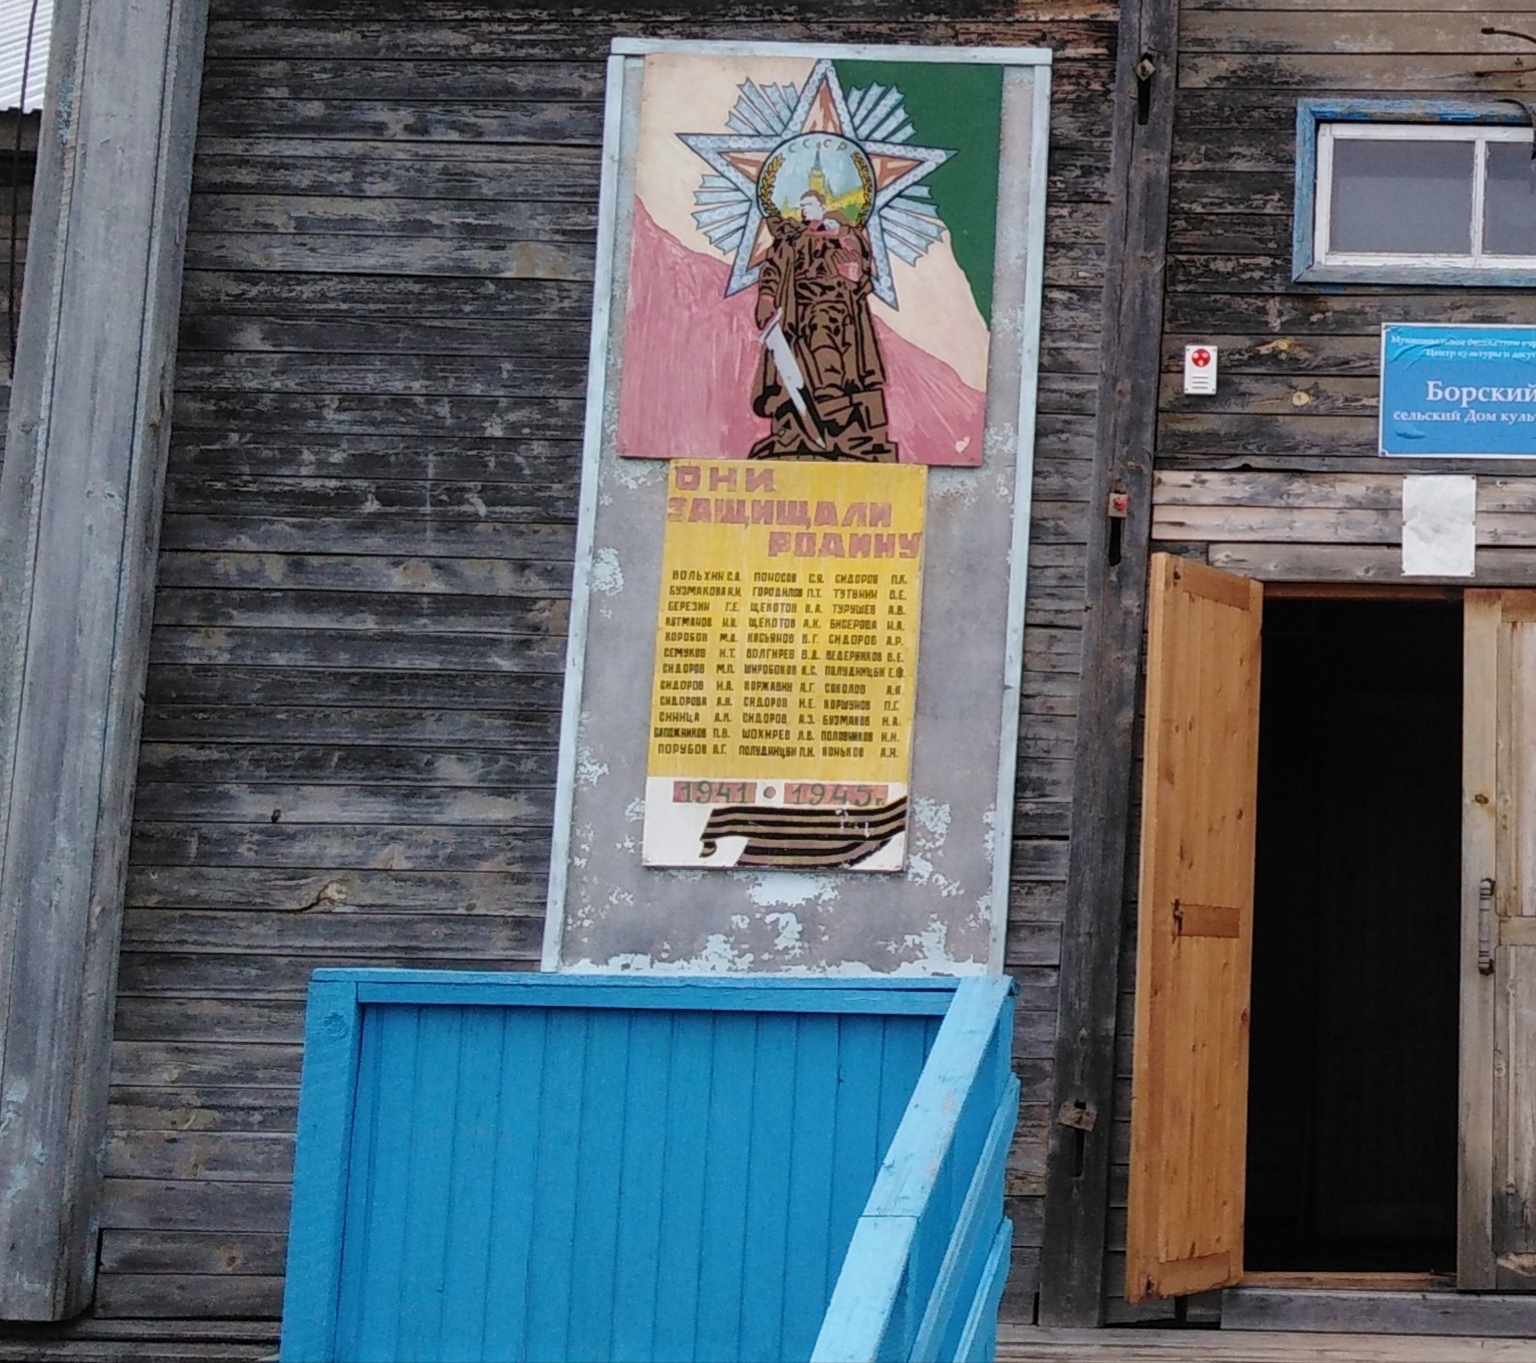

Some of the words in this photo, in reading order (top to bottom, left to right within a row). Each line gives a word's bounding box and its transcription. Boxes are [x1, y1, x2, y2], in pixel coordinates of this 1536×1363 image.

[1393, 409, 1460, 421] сельский
[1464, 409, 1496, 423] Дом
[675, 465, 774, 493] ОНИ
[668, 497, 892, 529] ЗАЩИЩАЛИ
[768, 531, 922, 559] РОДИНУ
[672, 570, 724, 580] ВОЛЬХИН
[754, 572, 796, 582] ПОНОСОВ
[835, 574, 878, 584] СИДОРОВ
[670, 585, 726, 596] БУЗМАКОВА
[753, 587, 803, 597] ГОРОДИЛОВ
[807, 588, 821, 598] П.Т.
[668, 602, 710, 611] БЕРЕЗИН
[725, 602, 739, 611] Г.Е.
[750, 602, 797, 613] ЩЕКОТОВ
[833, 604, 876, 614] ТУРУШЕВ
[749, 617, 796, 628] ЩЕКОТОВ
[830, 619, 877, 630] БИСЕРОВА
[748, 633, 794, 643] КАСЬЯНОВ
[802, 634, 819, 644] В.Г.
[829, 634, 877, 645] СИДОРОВ
[664, 648, 706, 658] СЕМУКОВ
[663, 663, 705, 674] СИДОРОВ
[716, 664, 735, 674] М.П.
[744, 664, 797, 675] ШИРОБОКОВ
[660, 681, 703, 690] СИДОРОВ
[825, 683, 866, 694] СОКОЛОВ
[660, 696, 707, 706] СИДОРОВА
[744, 697, 788, 707] СИДОРОВ
[824, 700, 870, 710] КОРШУНОВ
[659, 712, 700, 723] СИНИЦА
[743, 713, 787, 724] СИДОРОВ
[823, 715, 870, 726] БУЗМАКОВ
[713, 728, 730, 738] П.В.
[742, 729, 790, 740] ШОХИРЕВ
[658, 744, 707, 754] ПОРУБОВ
[822, 747, 864, 757] КОНЬКОВ
[681, 780, 748, 804] 1941
